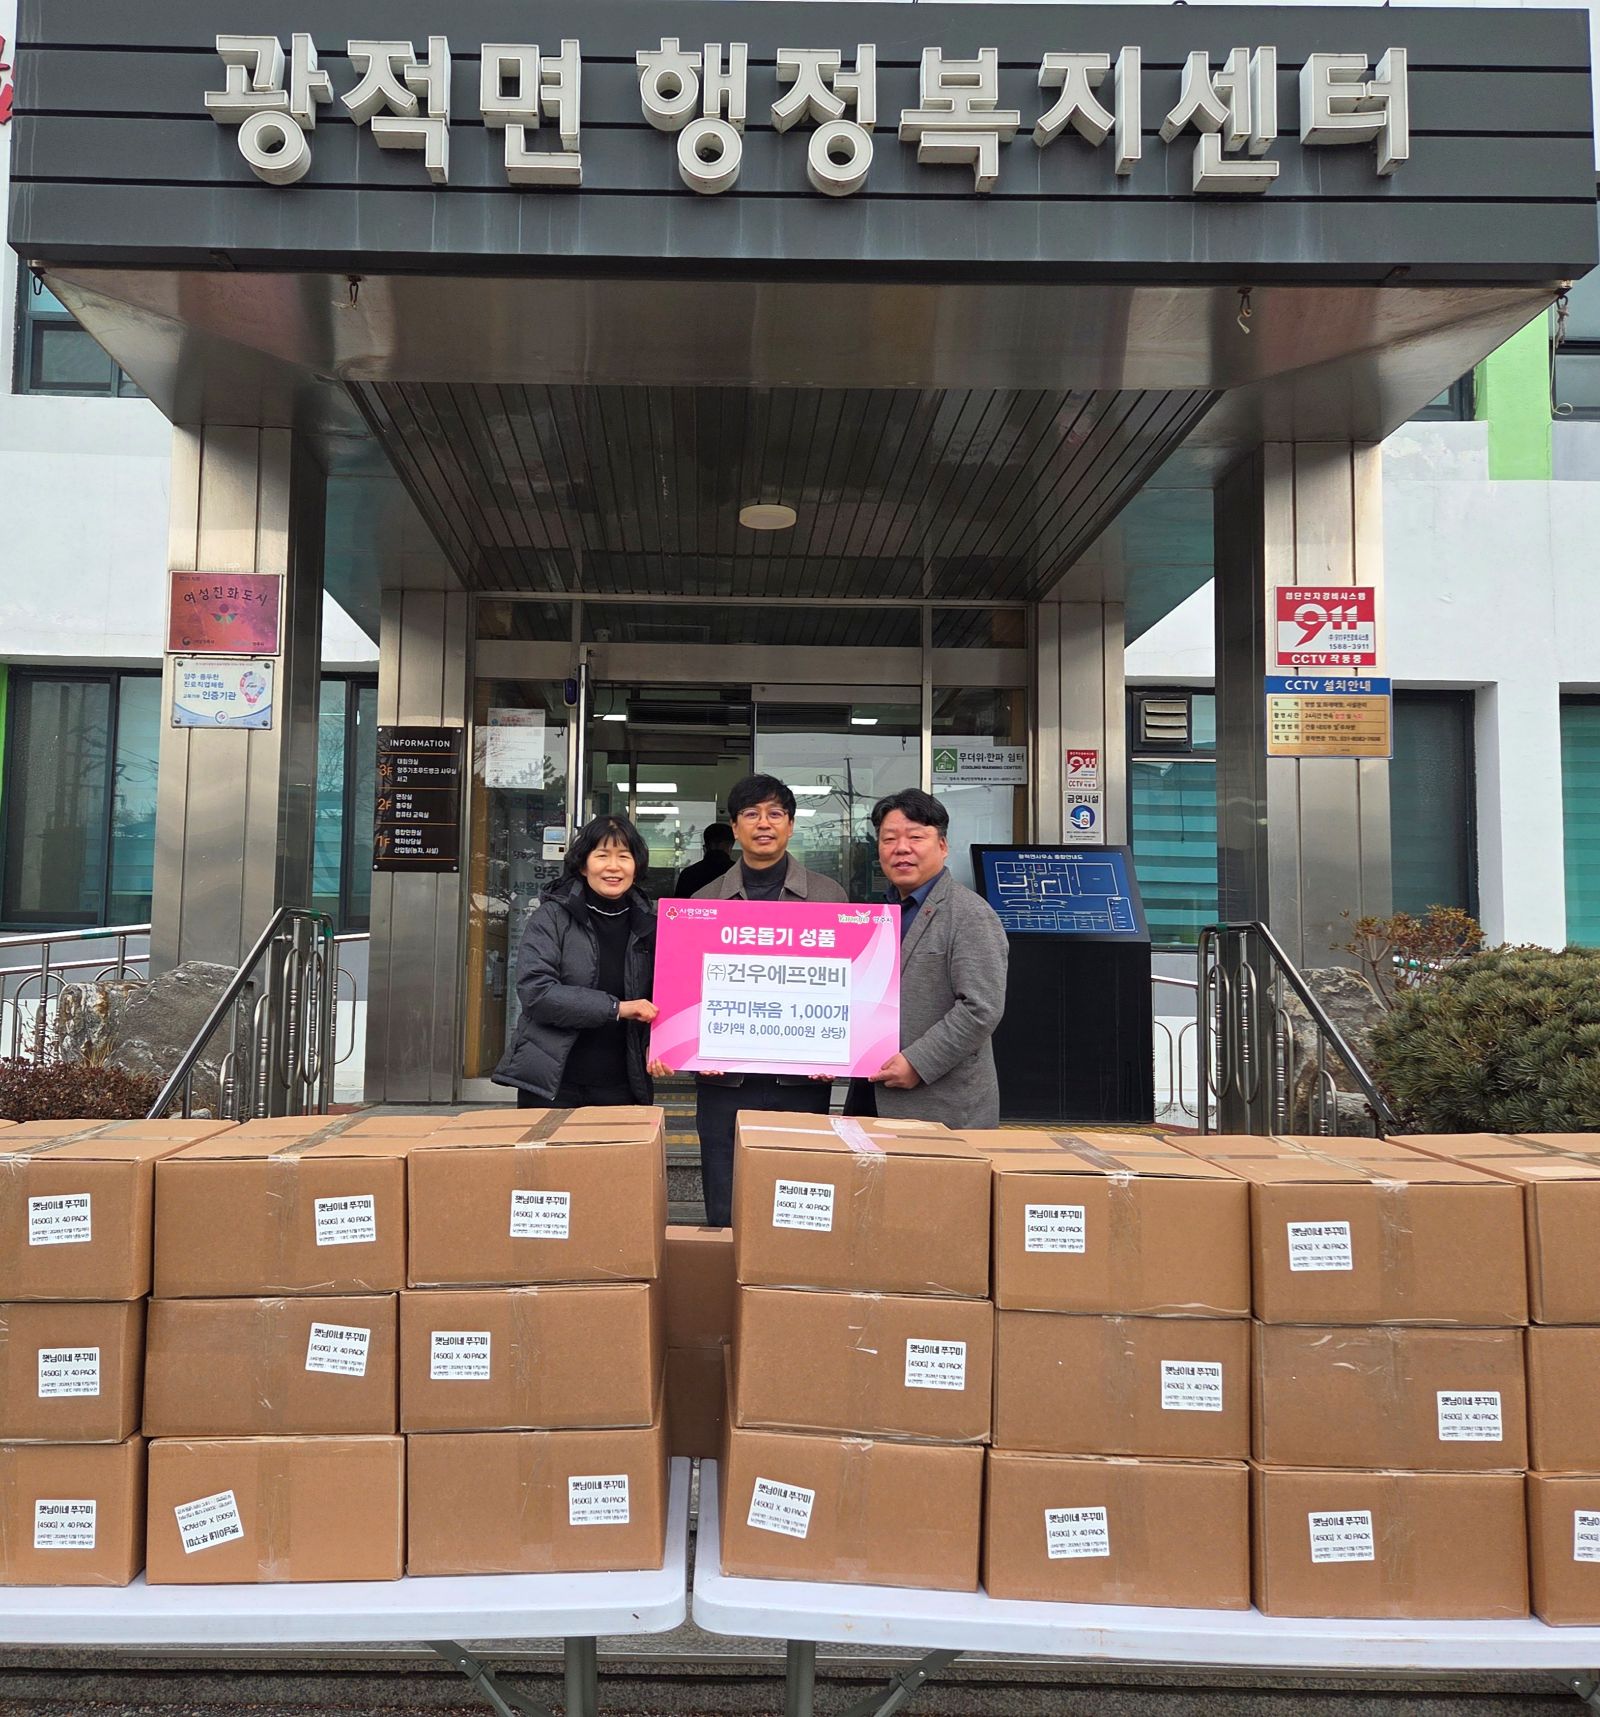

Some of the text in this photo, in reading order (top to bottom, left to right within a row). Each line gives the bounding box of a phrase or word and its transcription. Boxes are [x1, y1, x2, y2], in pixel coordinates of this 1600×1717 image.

[205, 33, 1409, 196] 광적면 행정복지센터
[183, 586, 268, 606] 여성친화도시
[1294, 603, 1358, 647] 911
[1291, 654, 1361, 664] CCTV 작동중
[1285, 680, 1371, 692] CCTV 설치안내
[202, 691, 236, 700] 인증기관
[389, 739, 450, 747] INFORMATION
[1008, 753, 1024, 762] 쉼터
[379, 764, 393, 776] 3F
[1069, 756, 1096, 774] 911
[1068, 780, 1084, 788] CCTV
[378, 798, 392, 810] 2F
[1067, 794, 1099, 804] 금연시설
[377, 835, 391, 848] 1F
[721, 926, 836, 948] 이웃돕기 성품
[706, 1000, 849, 1022] 쭈꾸미볶음 1,000개
[708, 1022, 846, 1039] (환가액 8,000,000원 상당)
[809, 1187, 831, 1197] 쭈꾸미
[64, 1198, 87, 1208] 쭈꾸미
[349, 1199, 371, 1209] 쭈꾸미
[545, 1196, 567, 1205] 쭈꾸미
[813, 1203, 830, 1211] PACK
[1060, 1210, 1082, 1218] 쭈꾸미
[1323, 1226, 1346, 1235] 쭈꾸미
[344, 1331, 366, 1342] 쭈꾸미
[465, 1336, 487, 1345] 쭈꾸미
[941, 1346, 962, 1355] 쭈꾸미
[74, 1352, 96, 1362] 쭈꾸미
[1196, 1367, 1219, 1376] 쭈꾸미
[1474, 1396, 1497, 1405] 쭈꾸미
[603, 1480, 625, 1489] 쭈꾸미
[788, 1490, 810, 1503] 쭈꾸미
[70, 1505, 93, 1514] 쭈꾸미
[791, 1508, 807, 1517] PACK
[1080, 1512, 1103, 1521] 쭈꾸미
[1345, 1516, 1368, 1525] 쭈꾸미
